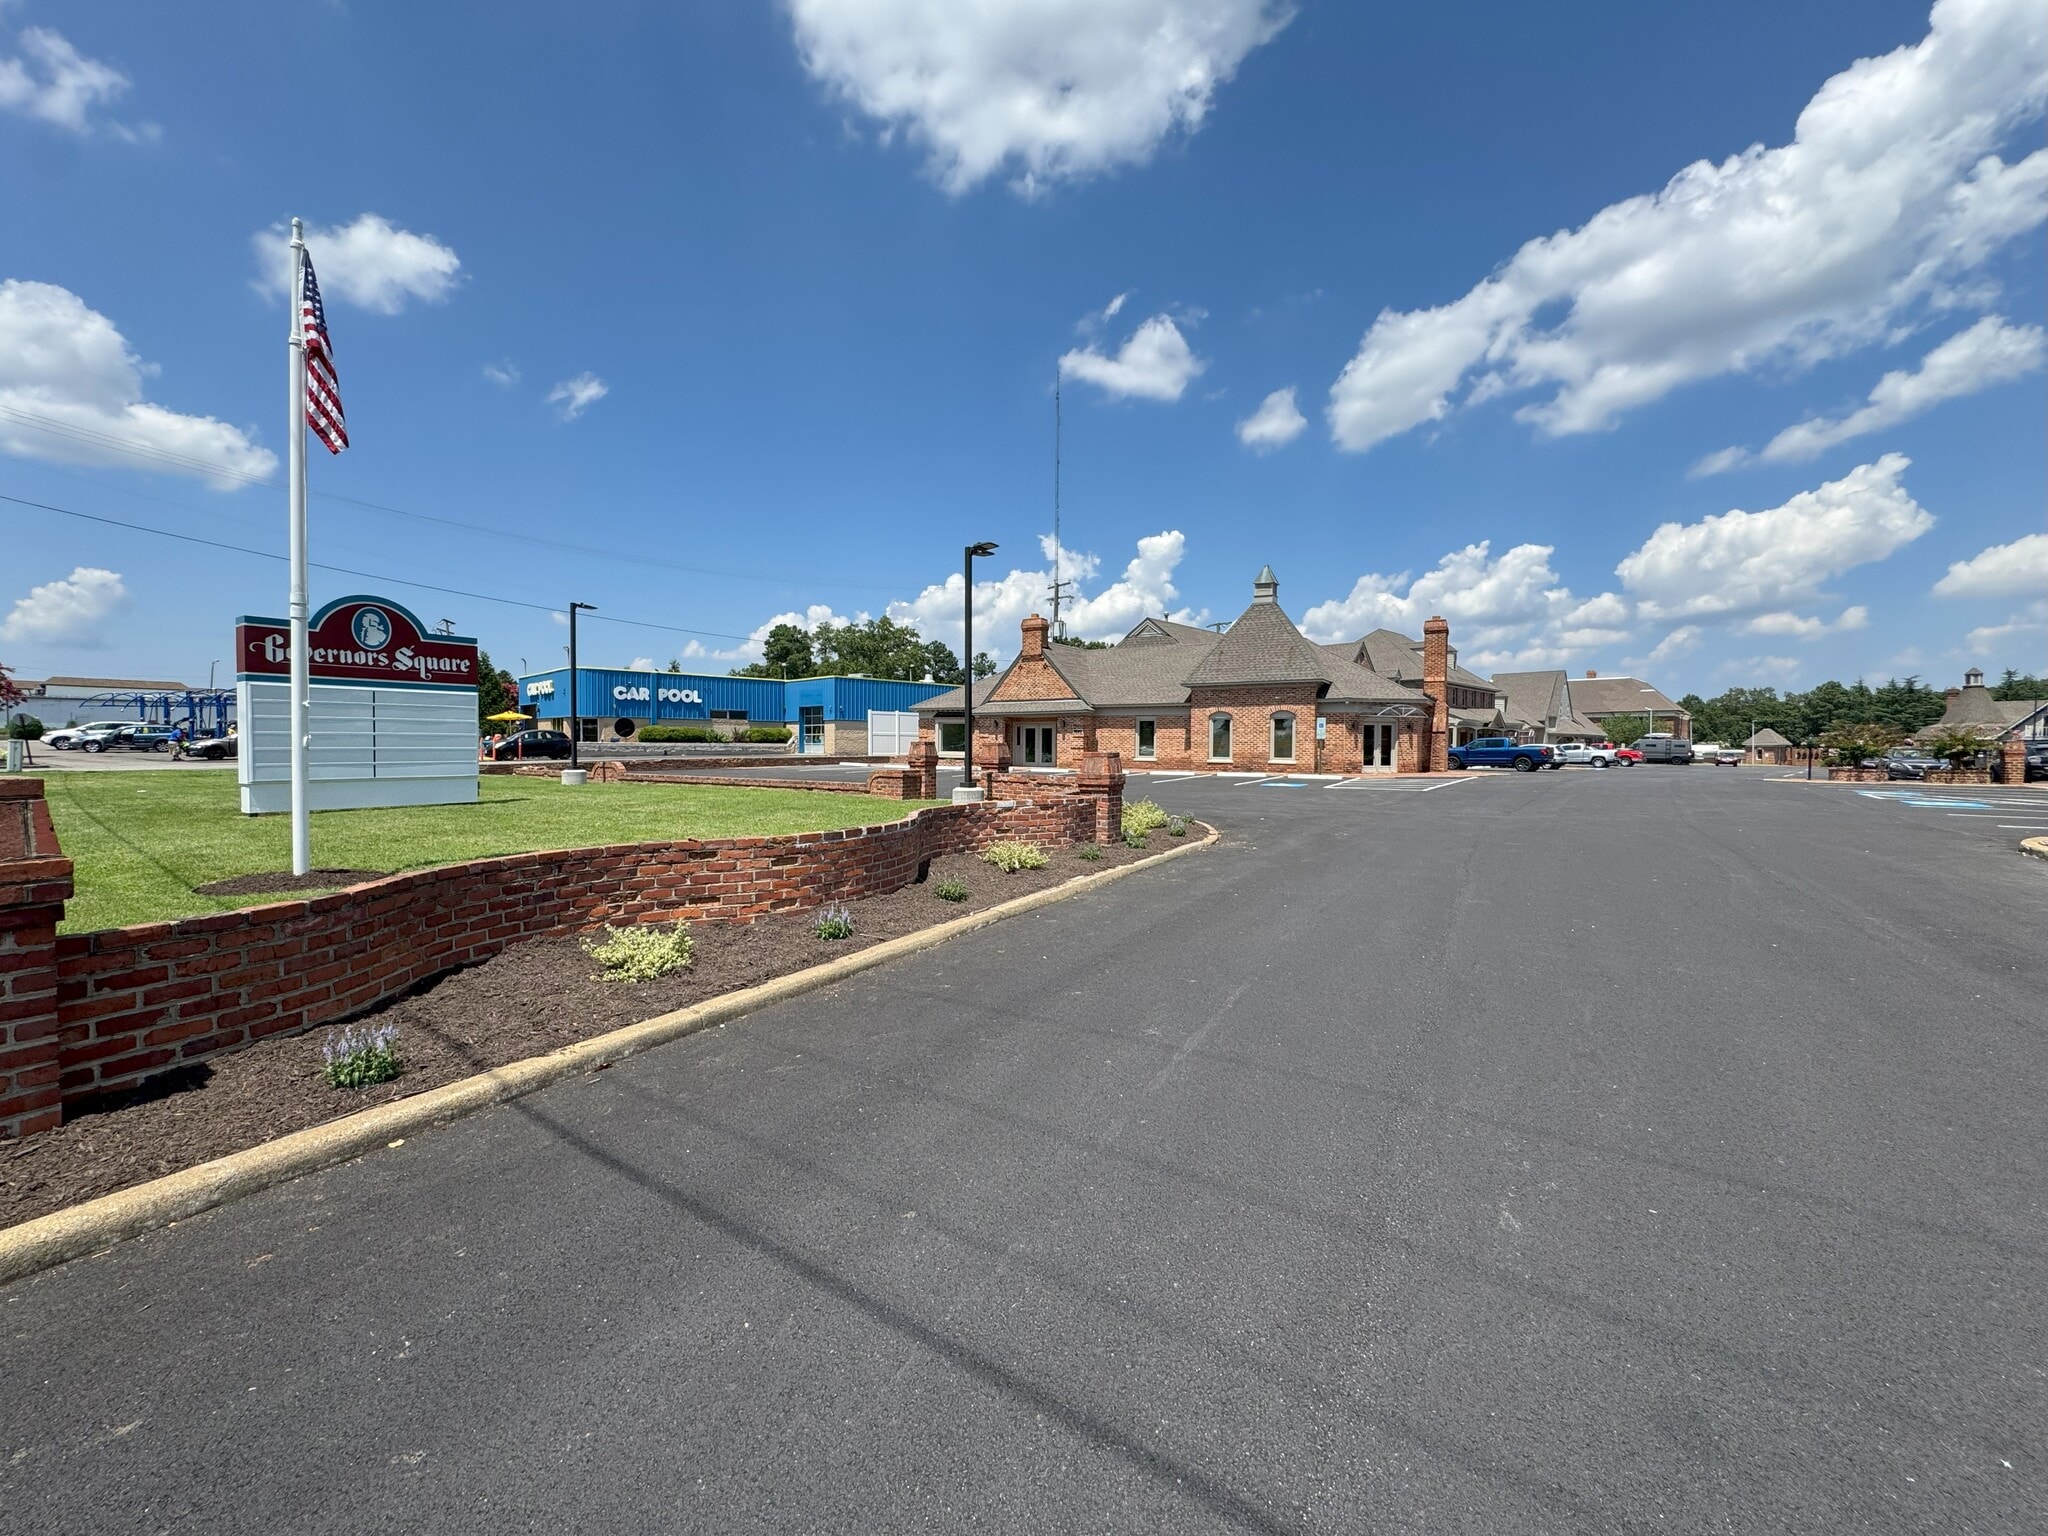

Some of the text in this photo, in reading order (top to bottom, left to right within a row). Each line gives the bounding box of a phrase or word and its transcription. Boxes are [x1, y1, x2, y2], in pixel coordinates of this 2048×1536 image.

[249, 634, 470, 680] Gernors Square
[613, 686, 702, 703] CAR POOL
